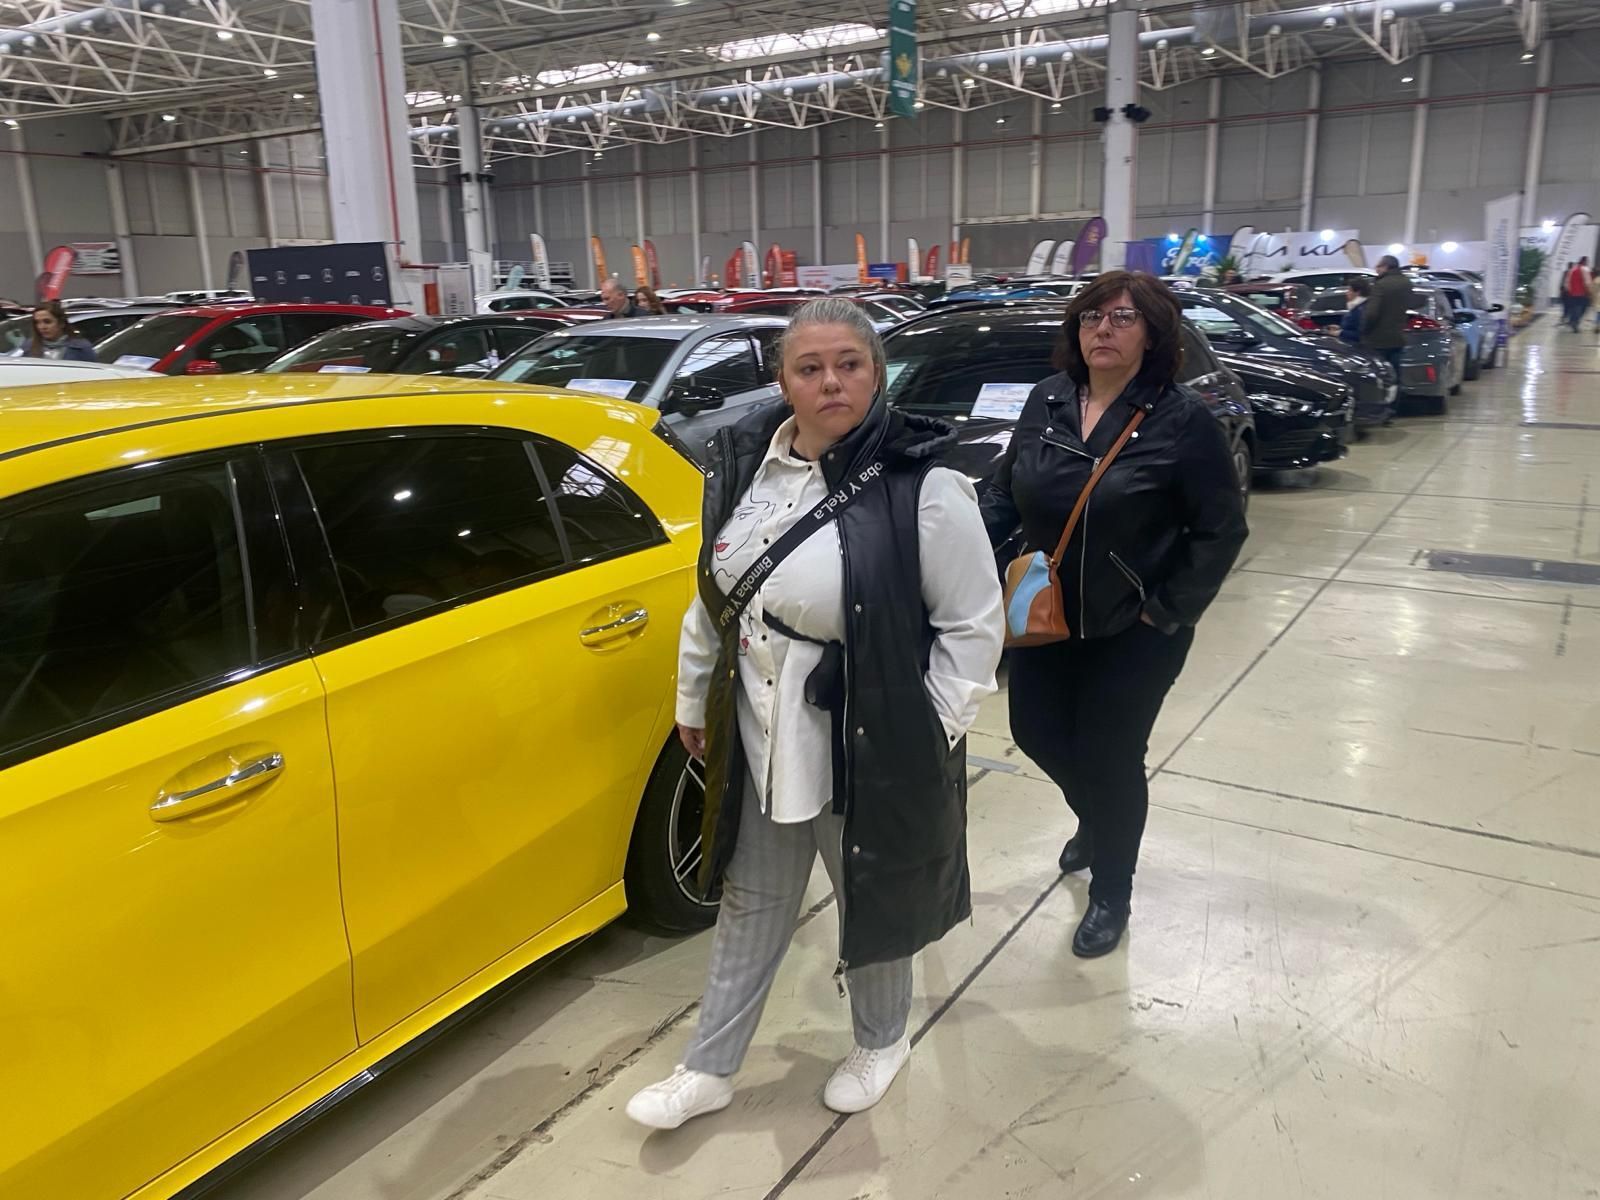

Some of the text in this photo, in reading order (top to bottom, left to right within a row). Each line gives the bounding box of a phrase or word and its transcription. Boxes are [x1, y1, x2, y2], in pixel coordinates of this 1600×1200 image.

[849, 482, 861, 495] Y
[813, 490, 848, 519] ReLa
[736, 556, 773, 597] Bimoba
[730, 598, 742, 610] Y
